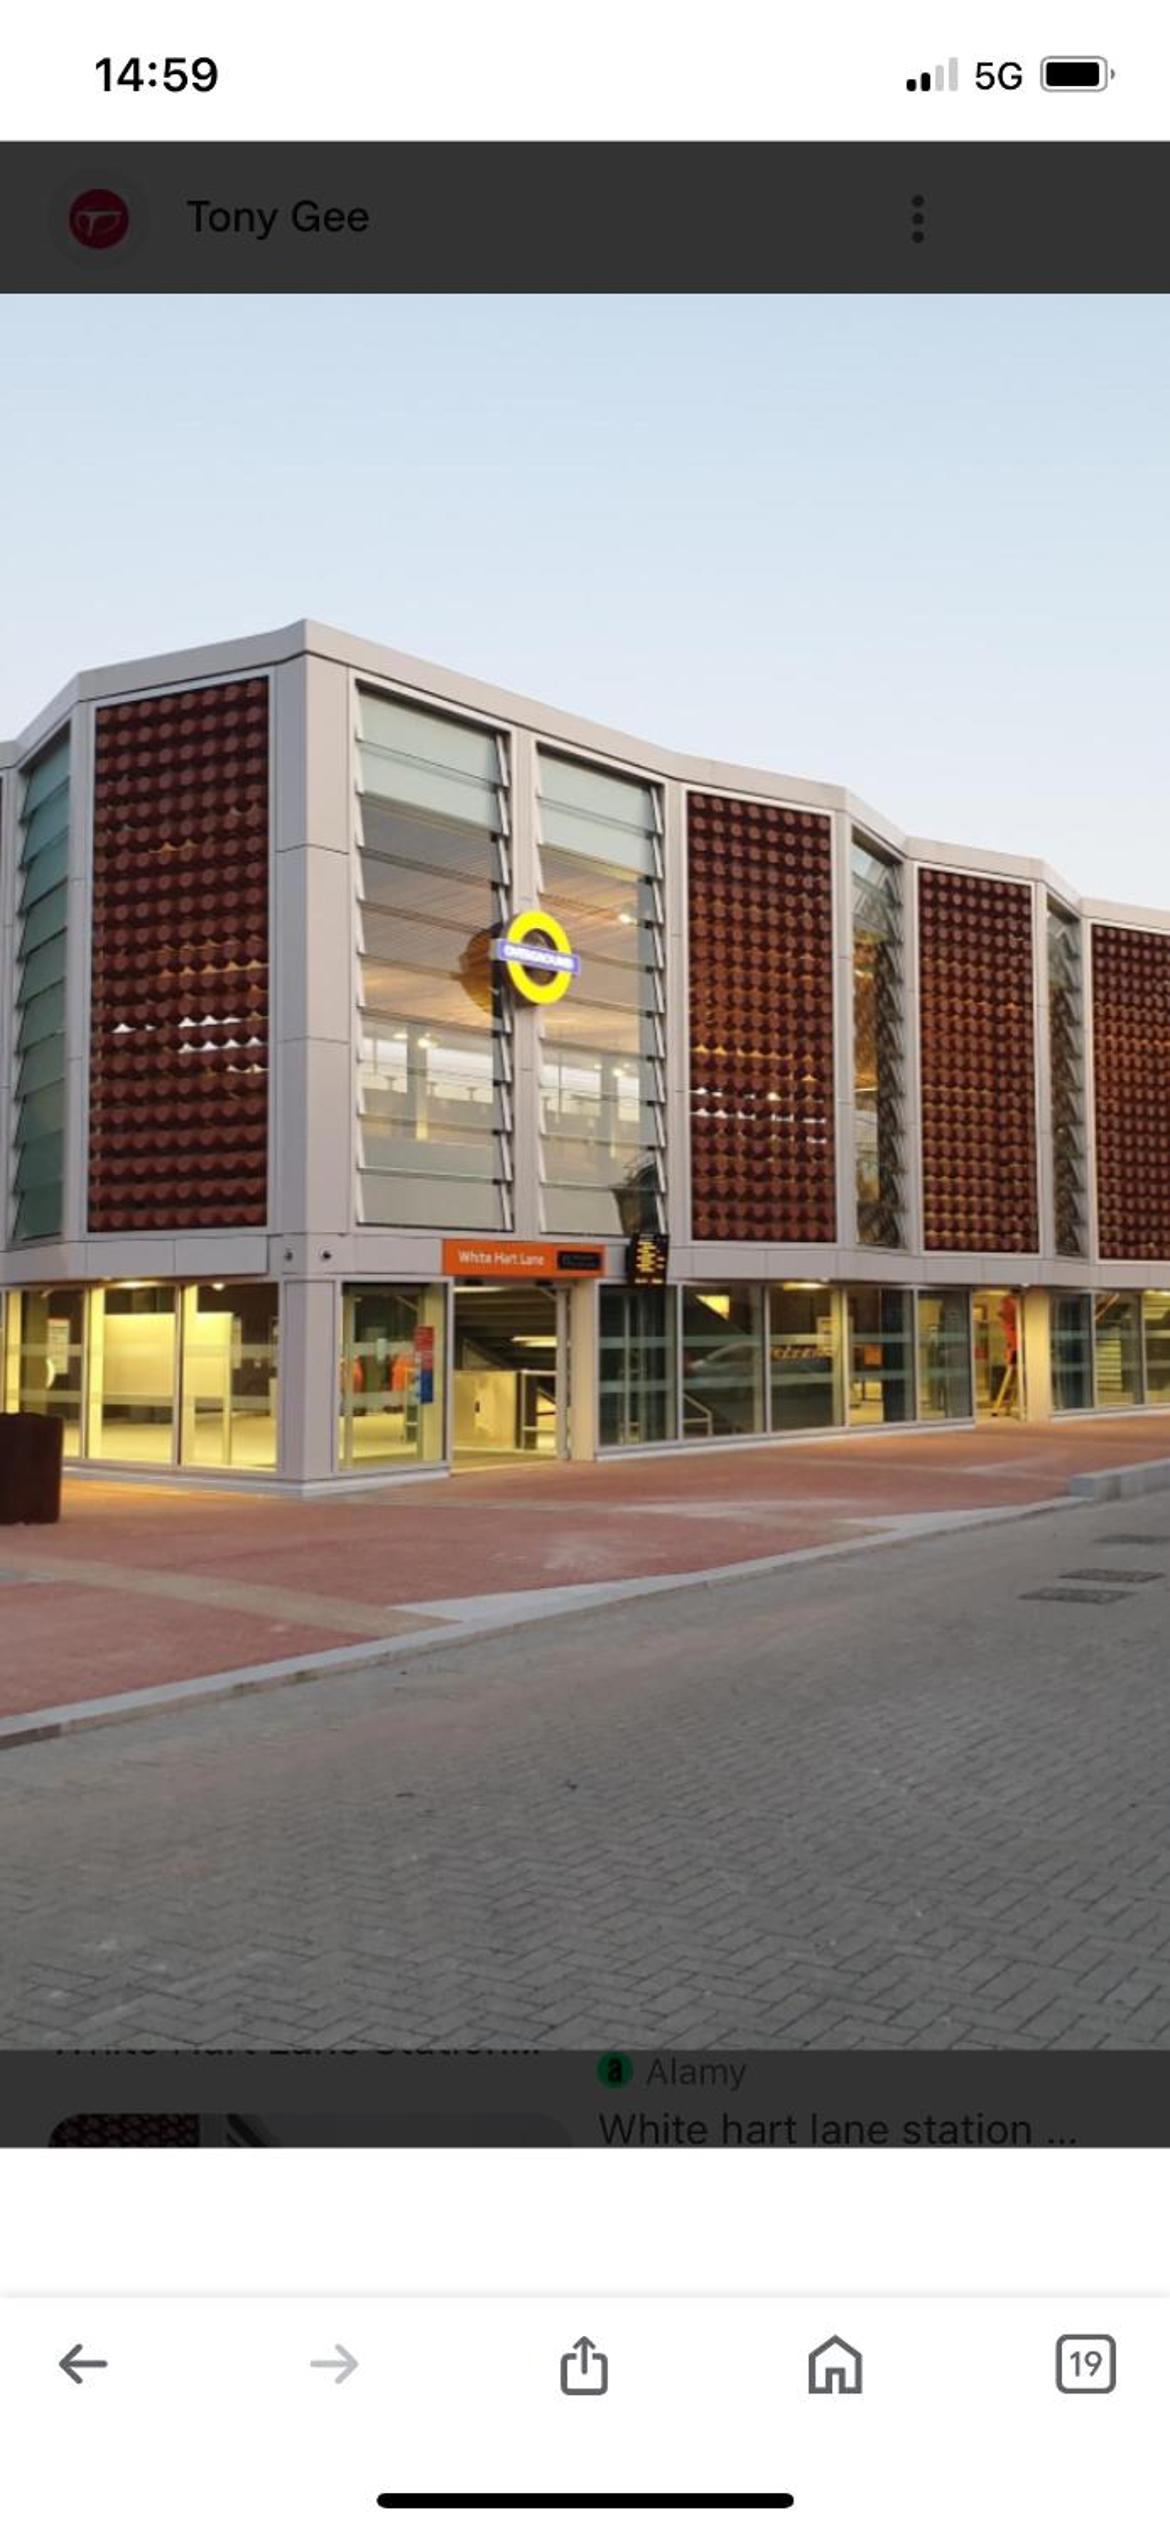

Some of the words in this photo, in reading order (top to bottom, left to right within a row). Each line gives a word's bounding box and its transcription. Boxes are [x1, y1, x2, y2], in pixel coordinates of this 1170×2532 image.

[458, 1249, 492, 1264] White
[494, 1251, 517, 1265] Hart
[518, 1252, 545, 1267] Lane
